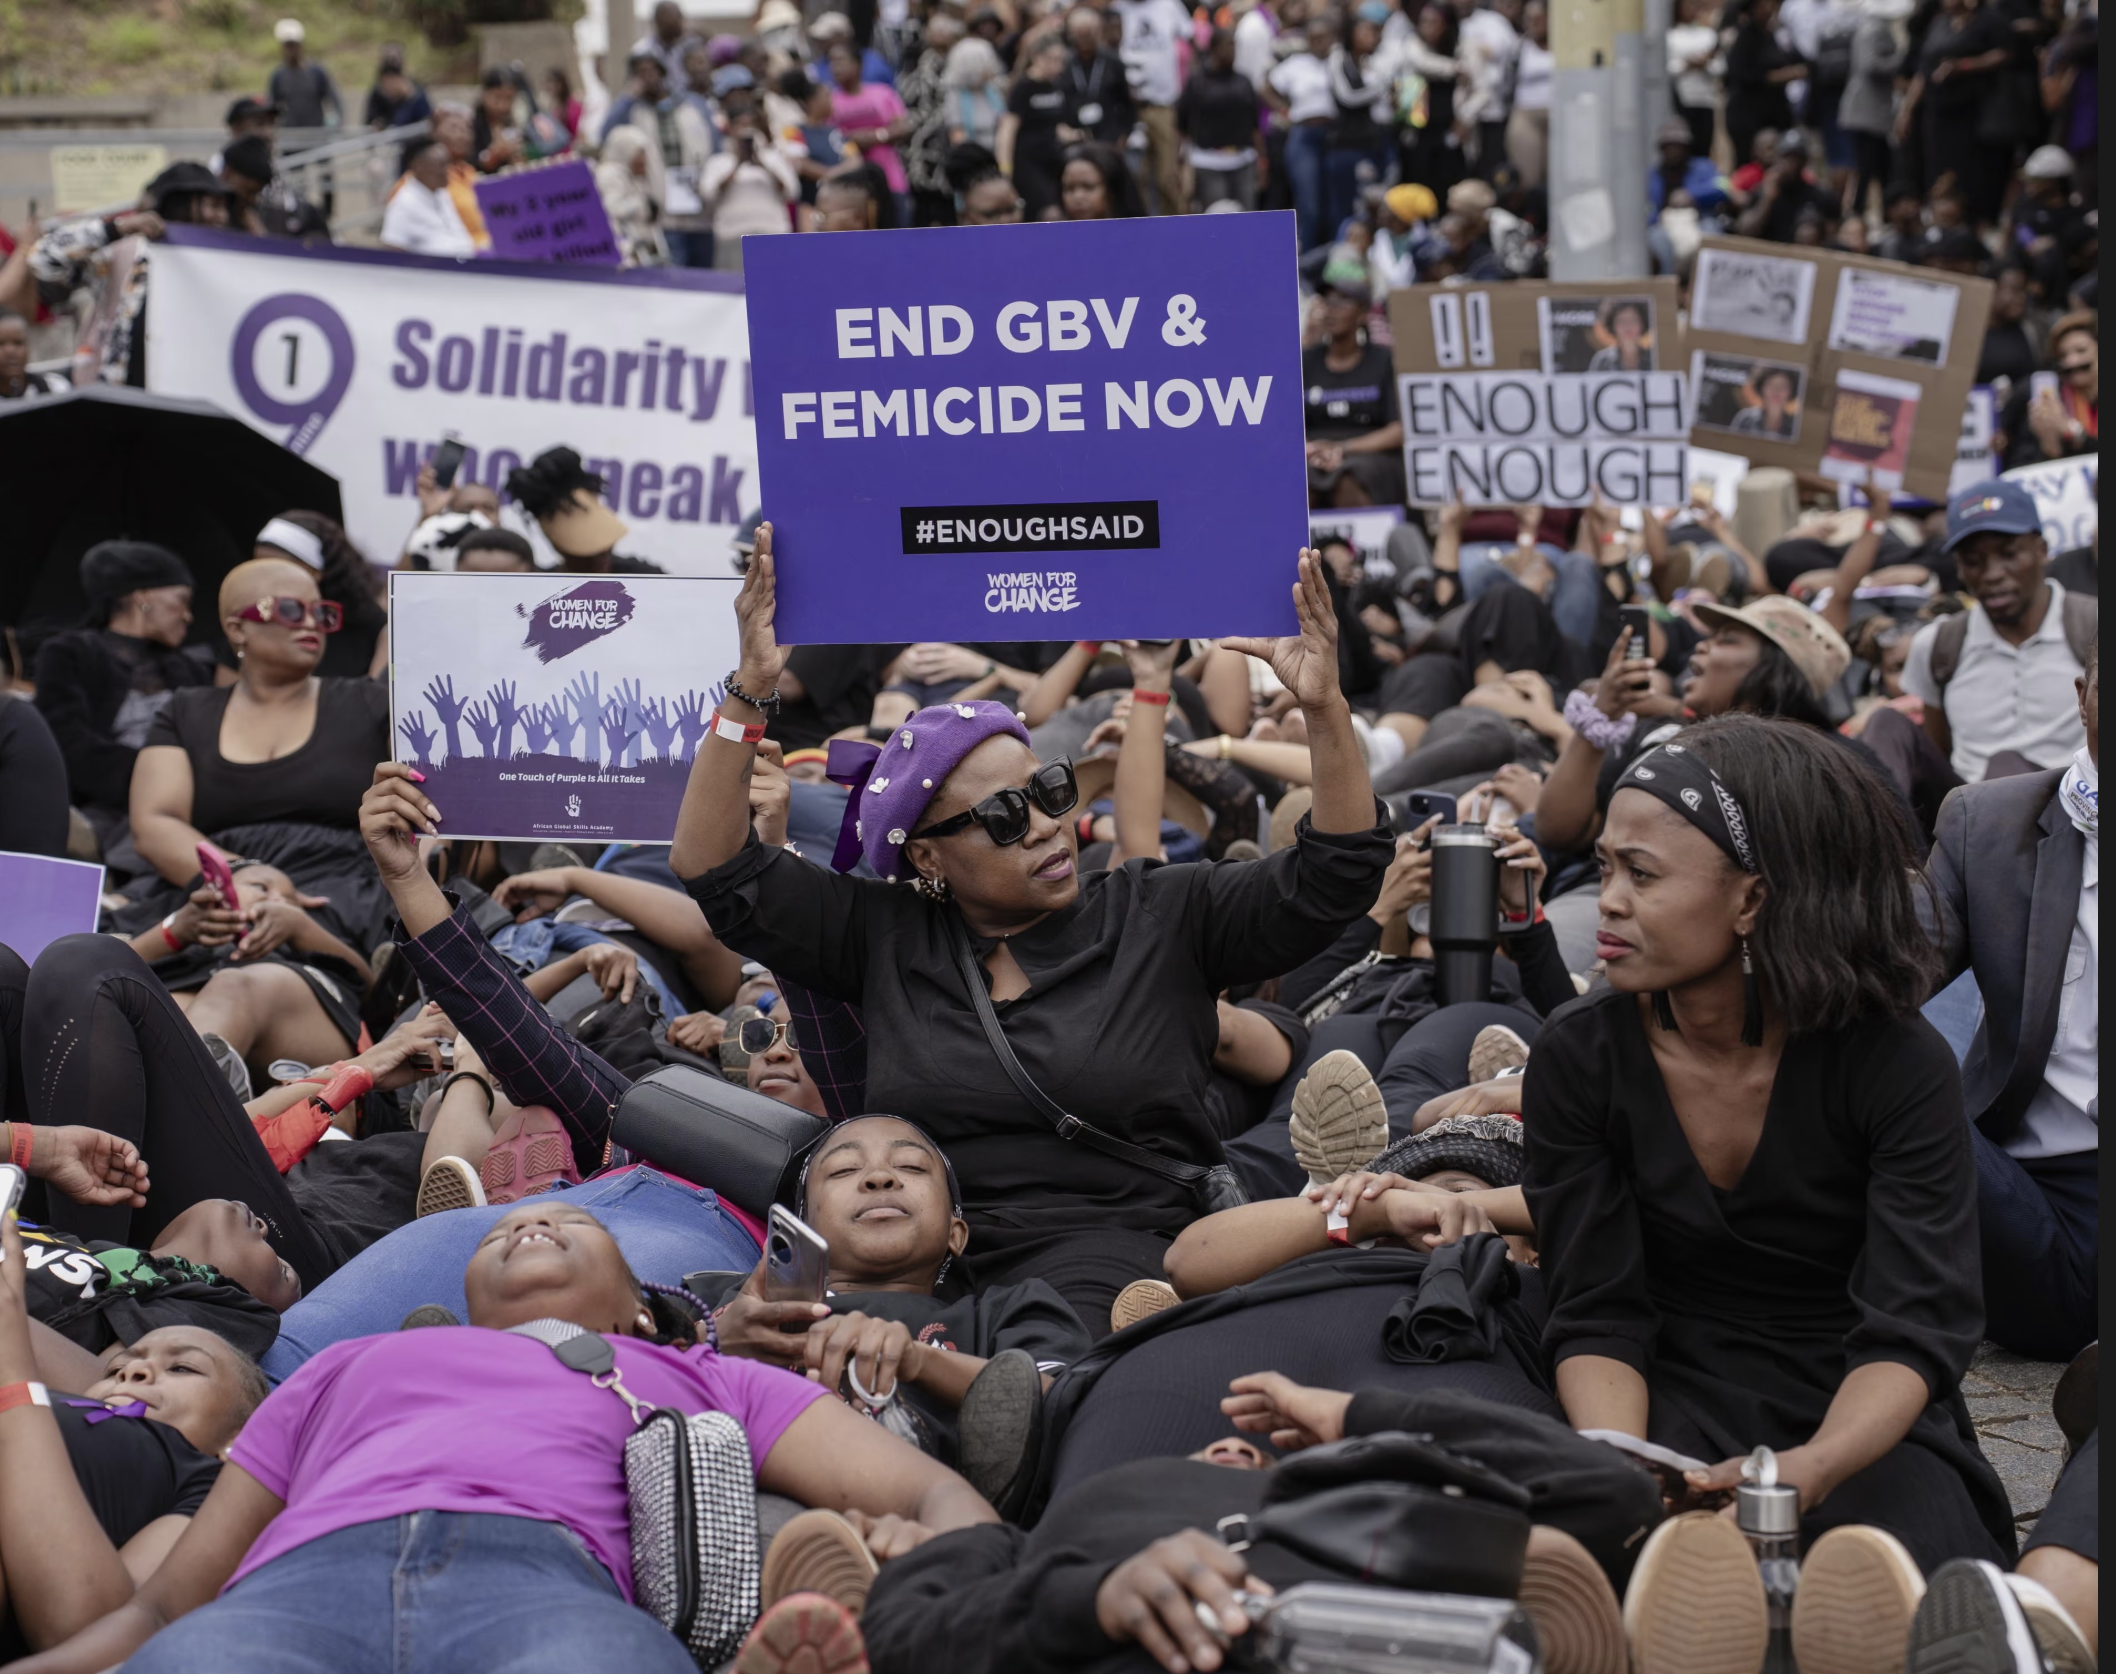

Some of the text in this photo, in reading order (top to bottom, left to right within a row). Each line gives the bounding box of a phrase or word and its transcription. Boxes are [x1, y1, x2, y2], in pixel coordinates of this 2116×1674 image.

[836, 294, 1207, 358] END GBV &
[392, 319, 726, 422] Solidarity
[782, 383, 1085, 440] FEMICIDE
[1105, 375, 1273, 430] NOW
[1408, 378, 1683, 438] ENOUGH
[1411, 447, 1685, 502] ENOUGH
[916, 515, 1144, 543] #ENOUGHSAID
[987, 571, 1076, 588] WOMEN FOR
[550, 599, 618, 611] WOMEN FOR
[984, 587, 1081, 613] CHANGE
[549, 611, 619, 629] CHANGE
[499, 772, 646, 784] One Touch of Purple Is All It Takes
